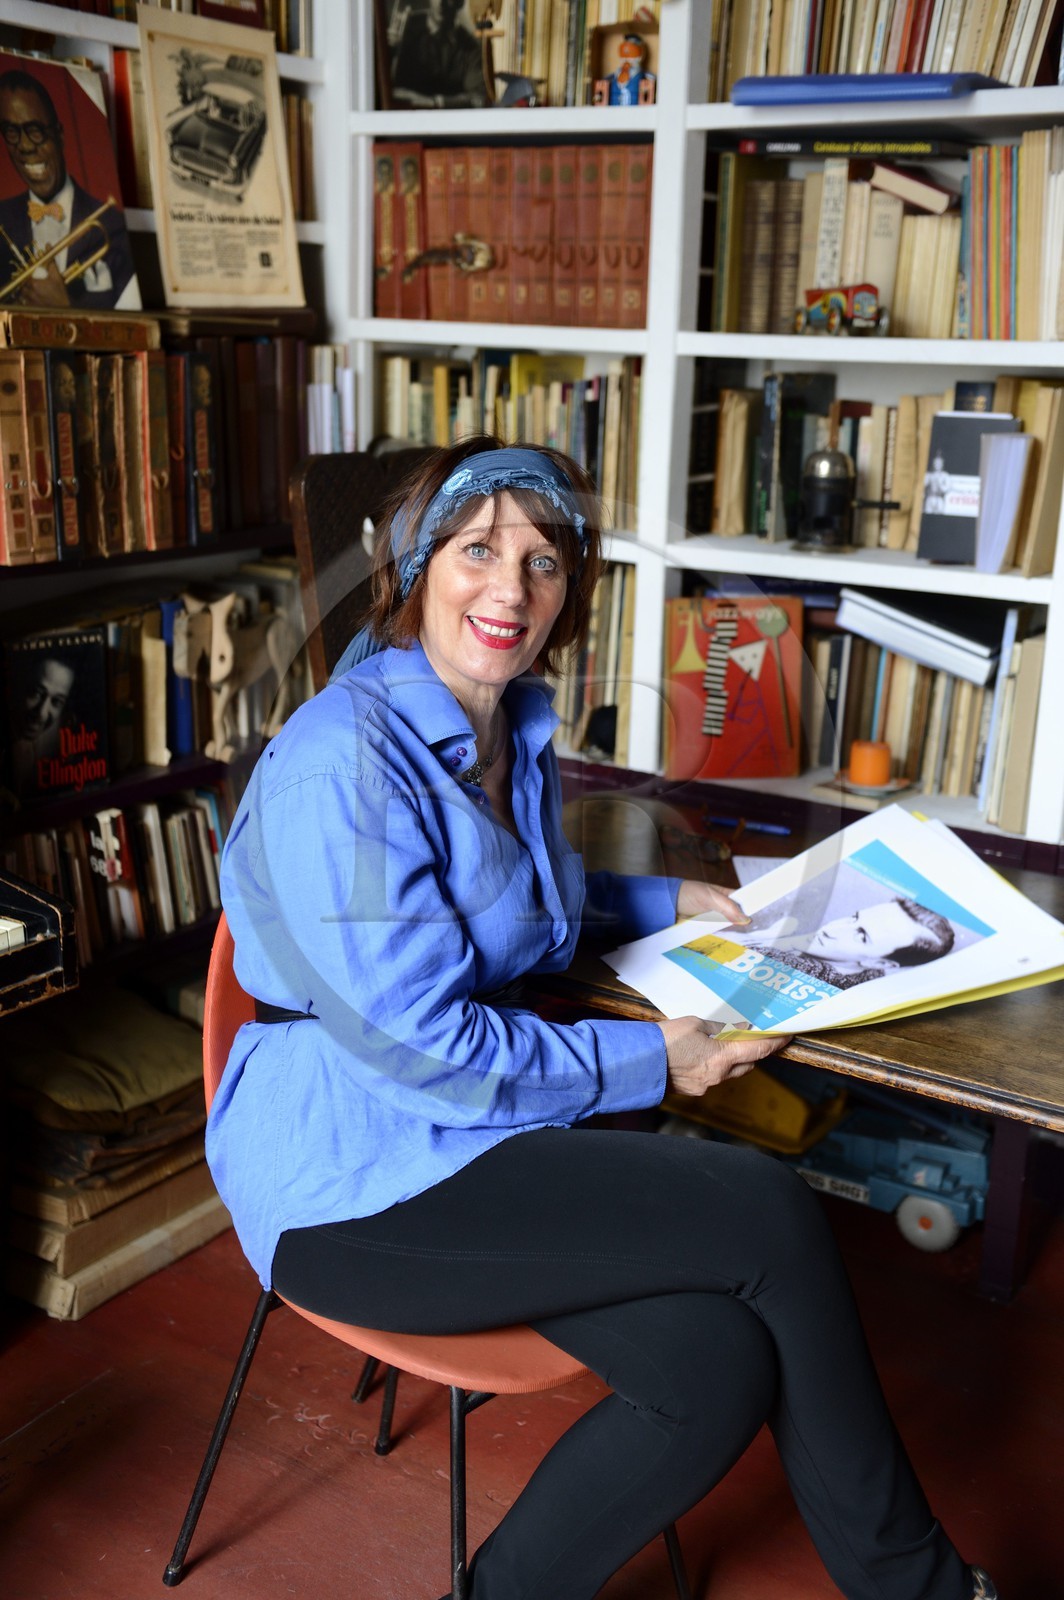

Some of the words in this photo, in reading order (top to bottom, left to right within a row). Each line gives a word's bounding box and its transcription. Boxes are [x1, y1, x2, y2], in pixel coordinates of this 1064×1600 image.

[59, 723, 98, 758] Duke
[37, 755, 107, 791] Ellington
[722, 948, 833, 1013] BORIS?
